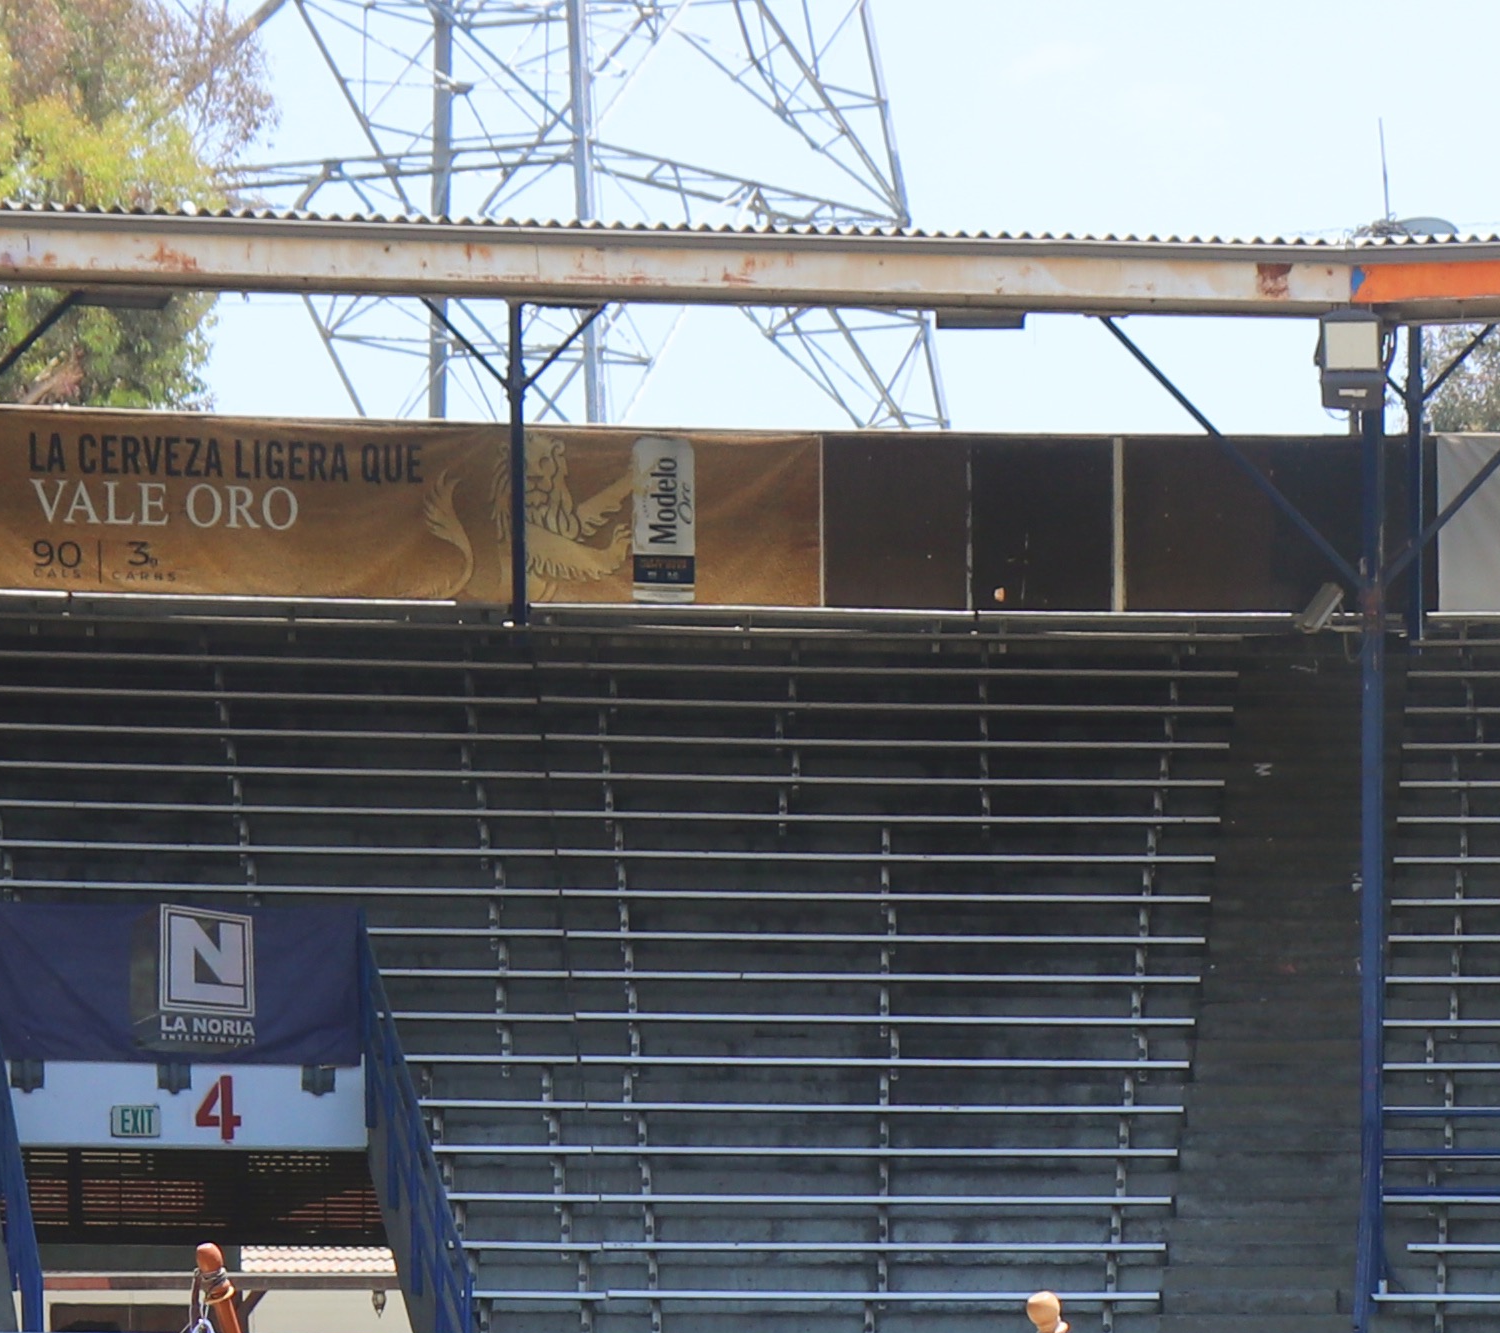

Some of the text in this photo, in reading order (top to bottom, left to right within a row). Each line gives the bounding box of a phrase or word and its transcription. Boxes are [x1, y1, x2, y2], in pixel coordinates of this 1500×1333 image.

[29, 432, 424, 486] LA CERVEZA LIGERA QUE
[29, 478, 300, 531] VALE ORO
[648, 457, 678, 544] Modelo
[32, 539, 82, 568] 90
[33, 567, 81, 579] CALS
[161, 1014, 255, 1036] LA NORIA
[161, 1032, 255, 1046] ENTERTAINMENT
[120, 1107, 154, 1135] EXIT
[194, 1074, 242, 1141] 4
